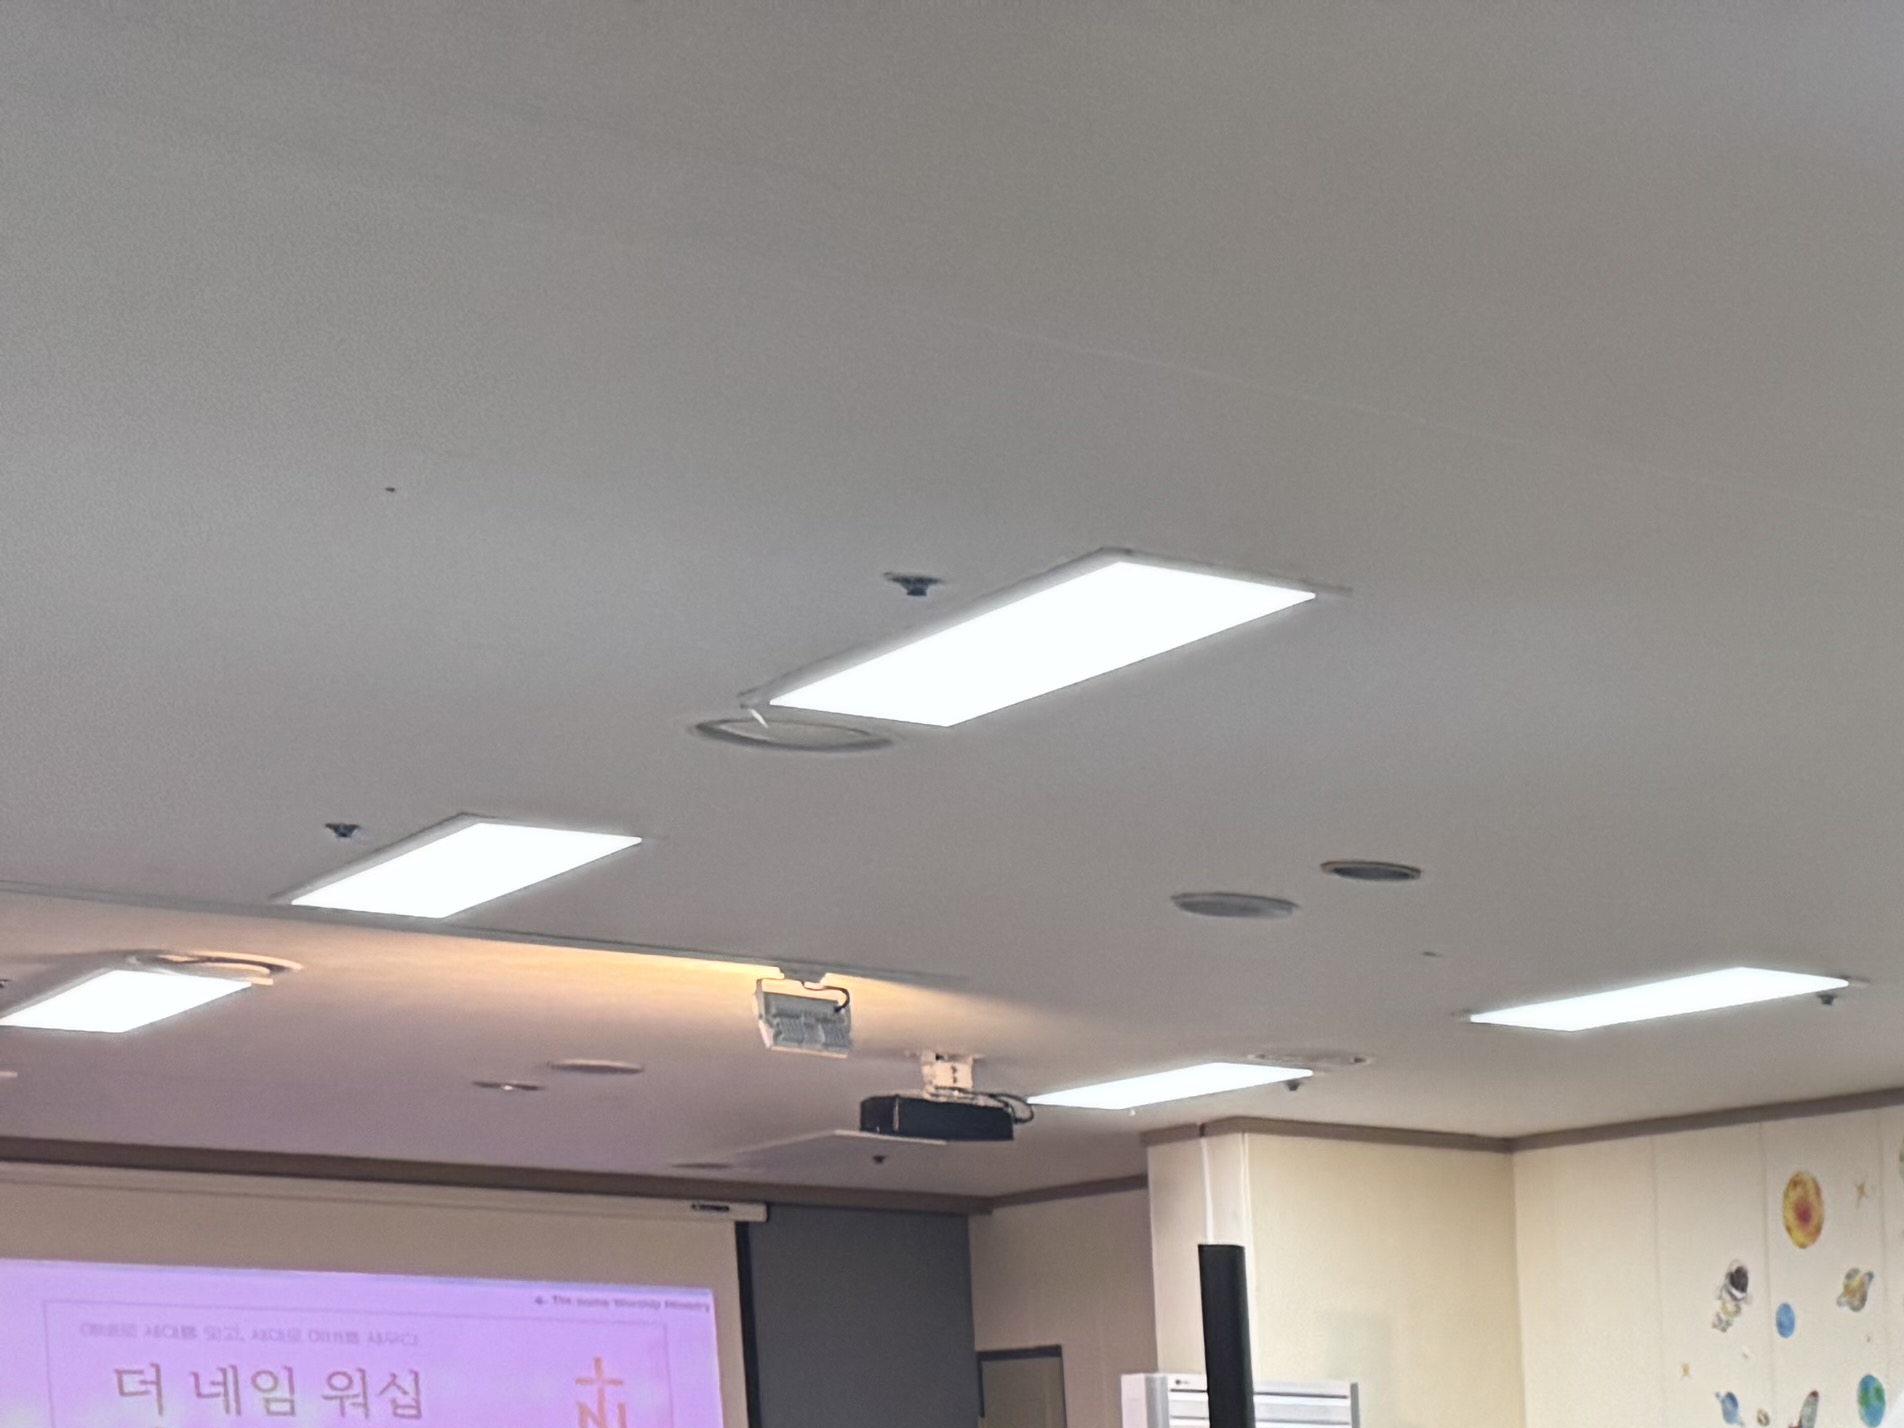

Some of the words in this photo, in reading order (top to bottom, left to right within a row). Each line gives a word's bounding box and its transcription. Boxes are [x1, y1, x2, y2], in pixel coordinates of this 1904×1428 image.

[114, 1362, 164, 1416] 더
[190, 1365, 297, 1417] 네임
[321, 1367, 422, 1419] 워십
